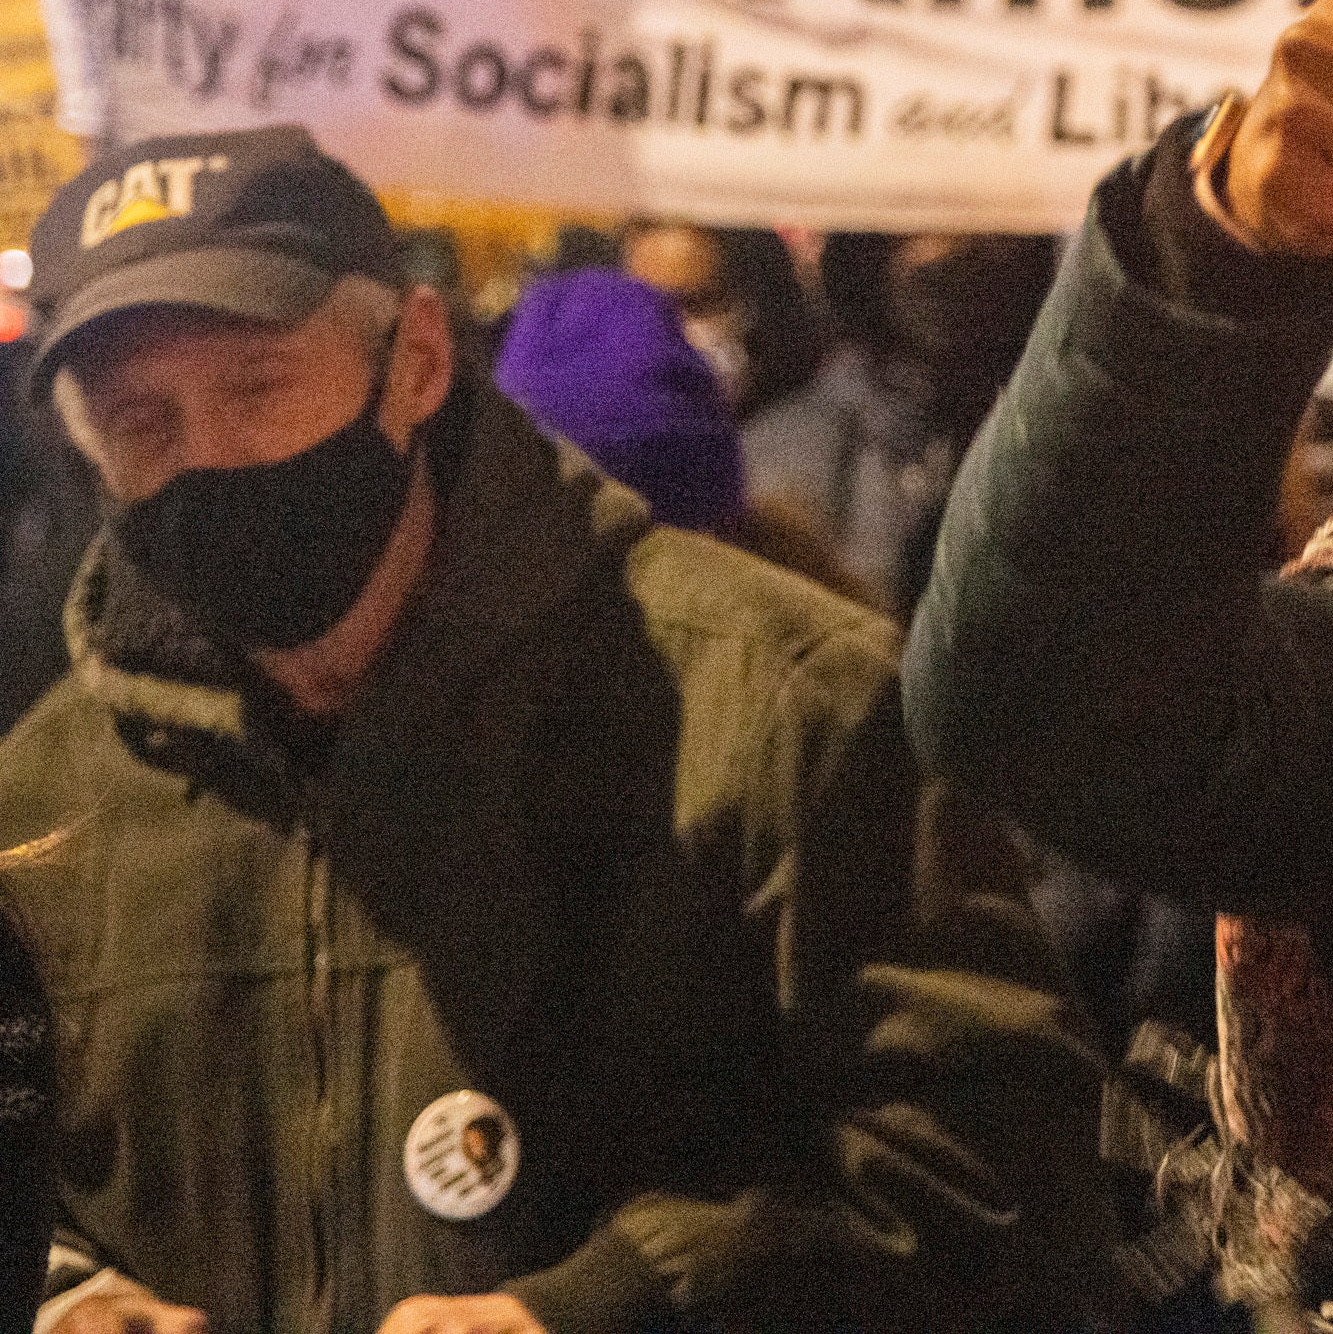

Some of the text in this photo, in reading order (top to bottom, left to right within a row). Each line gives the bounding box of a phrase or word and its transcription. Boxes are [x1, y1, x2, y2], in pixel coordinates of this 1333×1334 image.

[384, 6, 865, 137] Socialism
[1044, 68, 1186, 145] Lib
[80, 156, 204, 248] CAT
